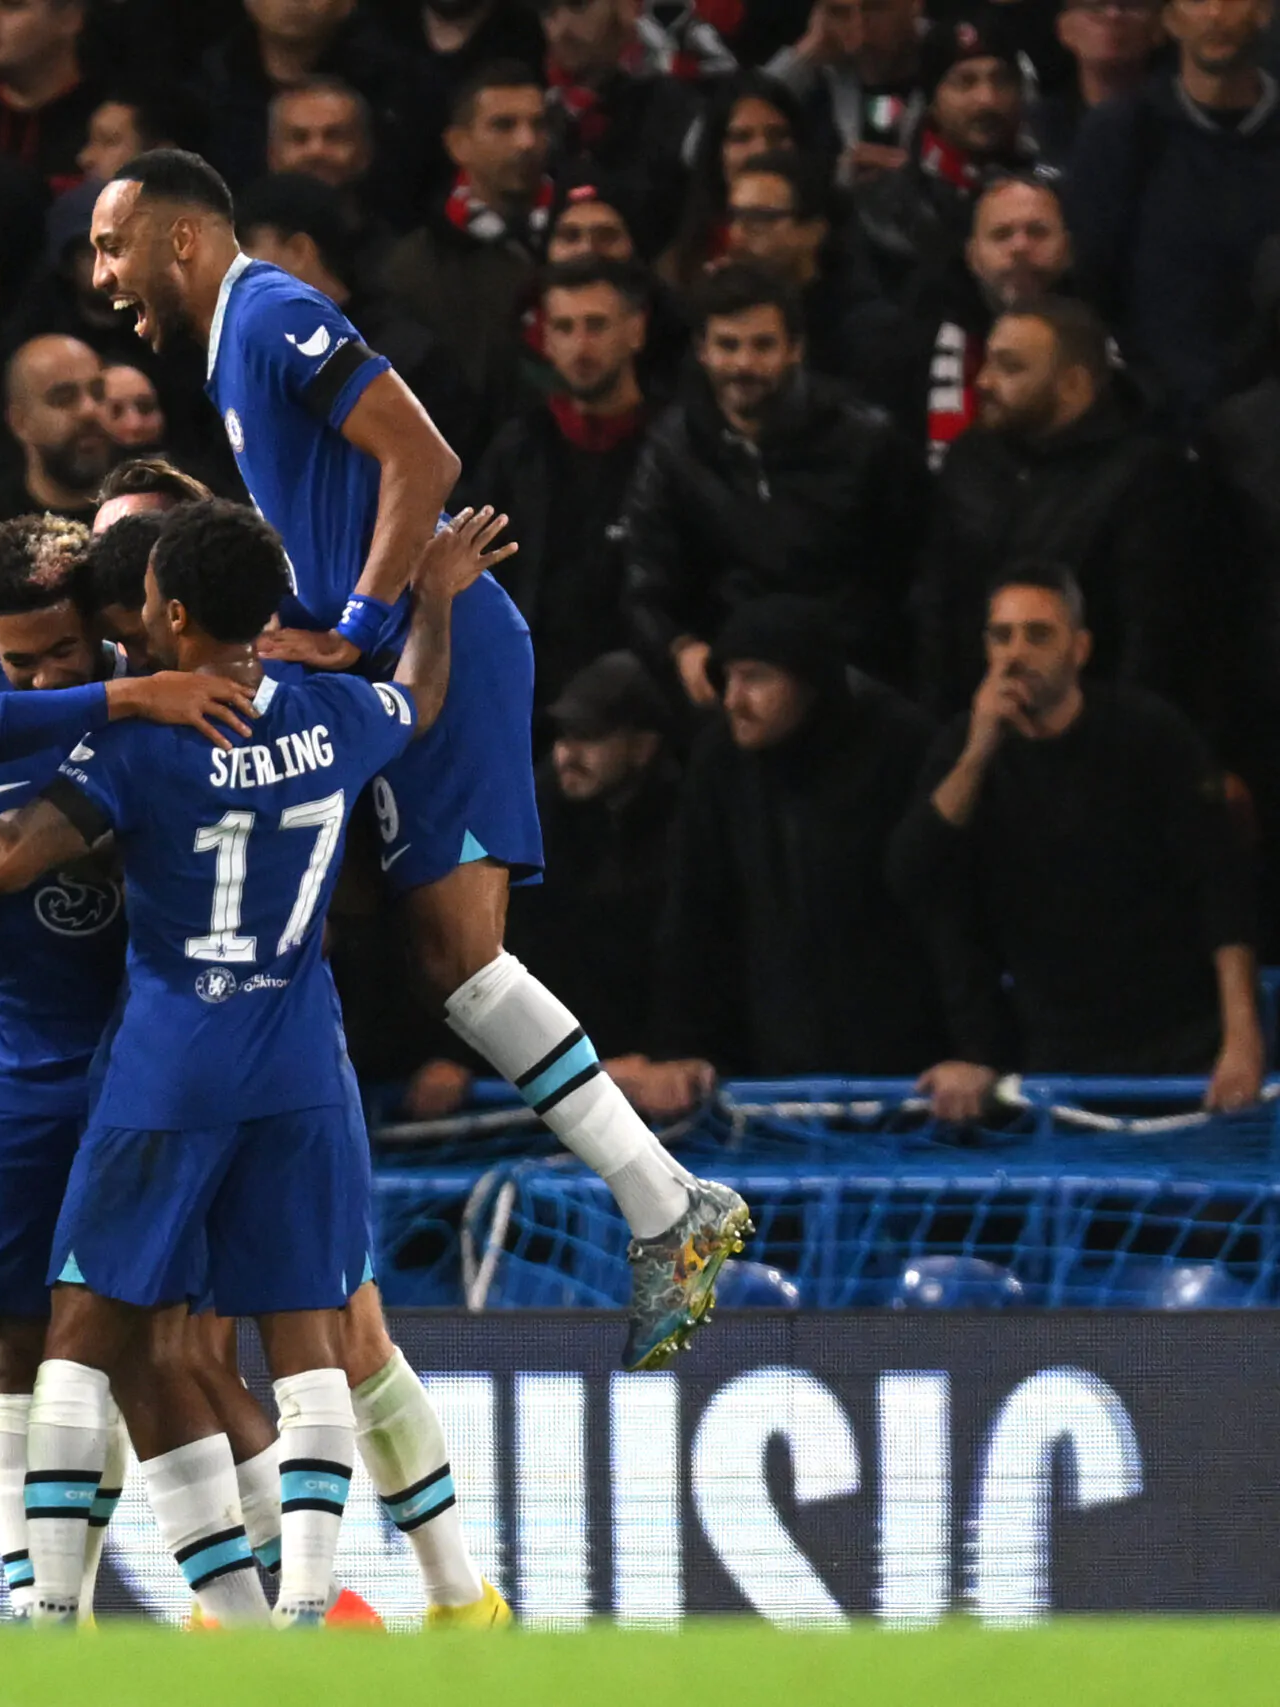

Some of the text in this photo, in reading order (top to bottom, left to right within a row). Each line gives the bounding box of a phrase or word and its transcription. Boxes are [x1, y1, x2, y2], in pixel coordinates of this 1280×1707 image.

[209, 724, 334, 788] STERLING
[373, 775, 399, 844] 9
[184, 788, 344, 962] 17
